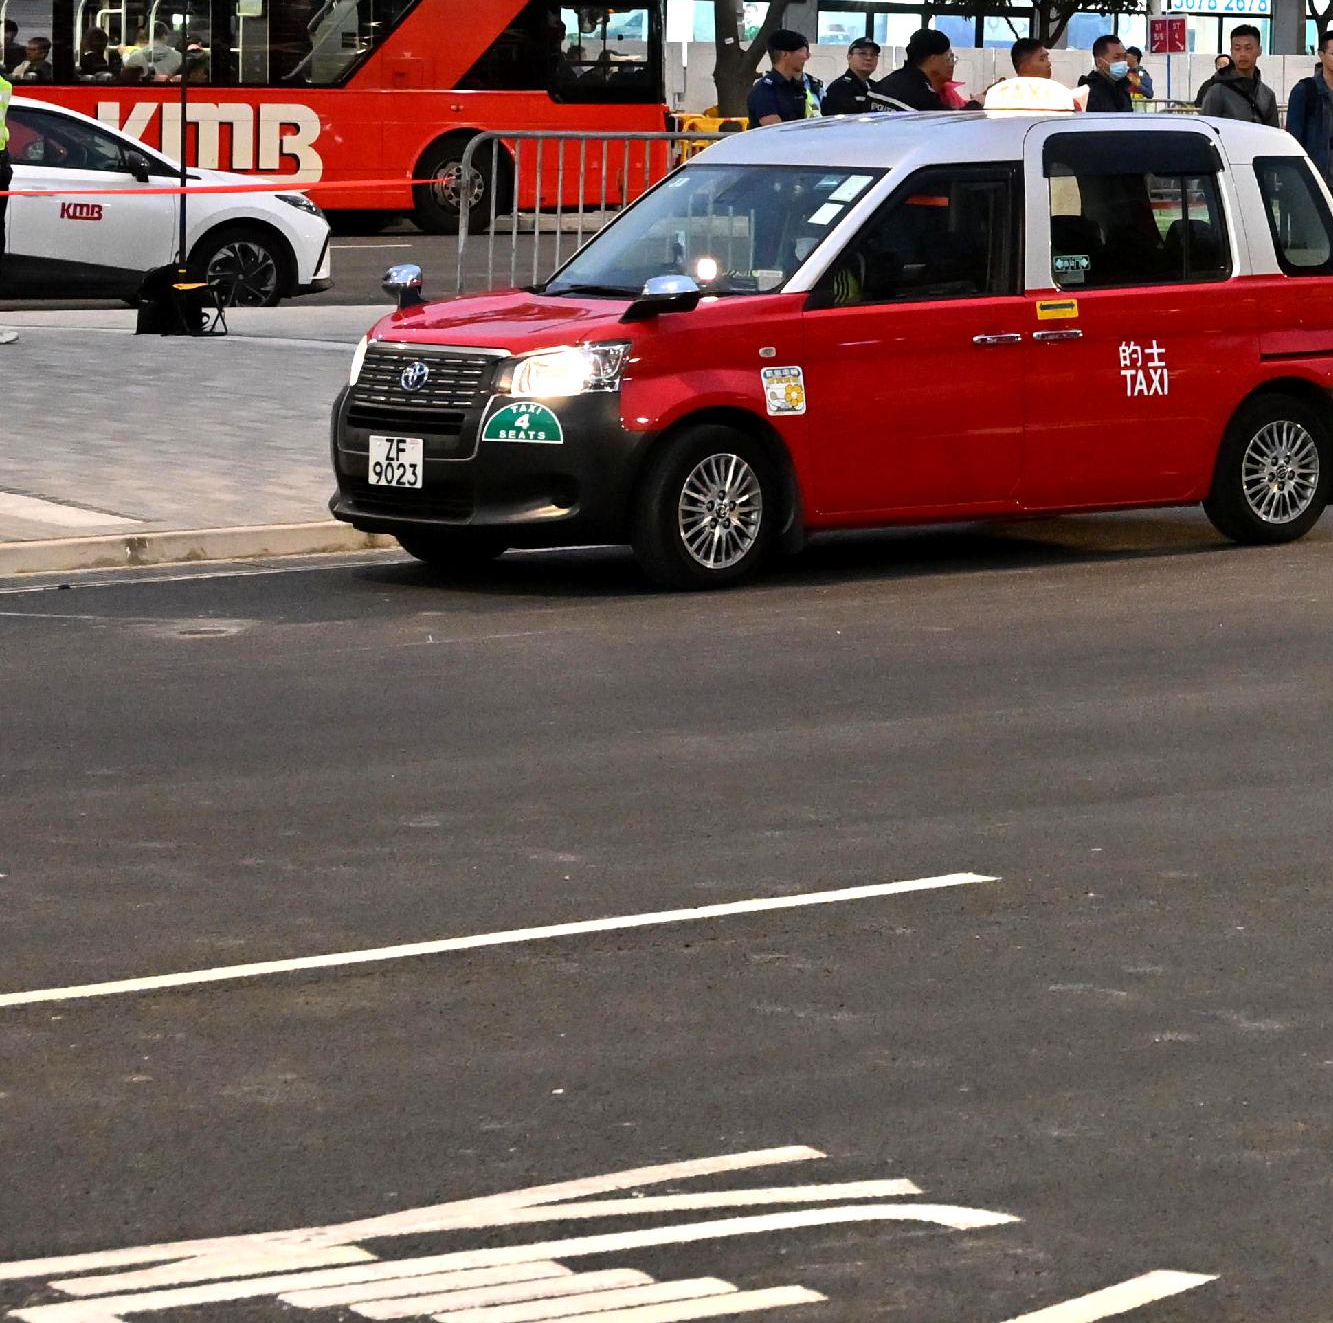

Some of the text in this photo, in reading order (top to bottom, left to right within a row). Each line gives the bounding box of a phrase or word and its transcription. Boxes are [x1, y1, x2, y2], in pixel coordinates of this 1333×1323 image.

[60, 202, 103, 221] KMB
[1119, 339, 1166, 367] 的士
[1120, 369, 1168, 397] TAXI
[511, 404, 542, 415] TAXI
[514, 413, 529, 430] 4
[499, 429, 546, 440] SEATS
[385, 438, 407, 462] ZF
[373, 462, 418, 487] 9023
